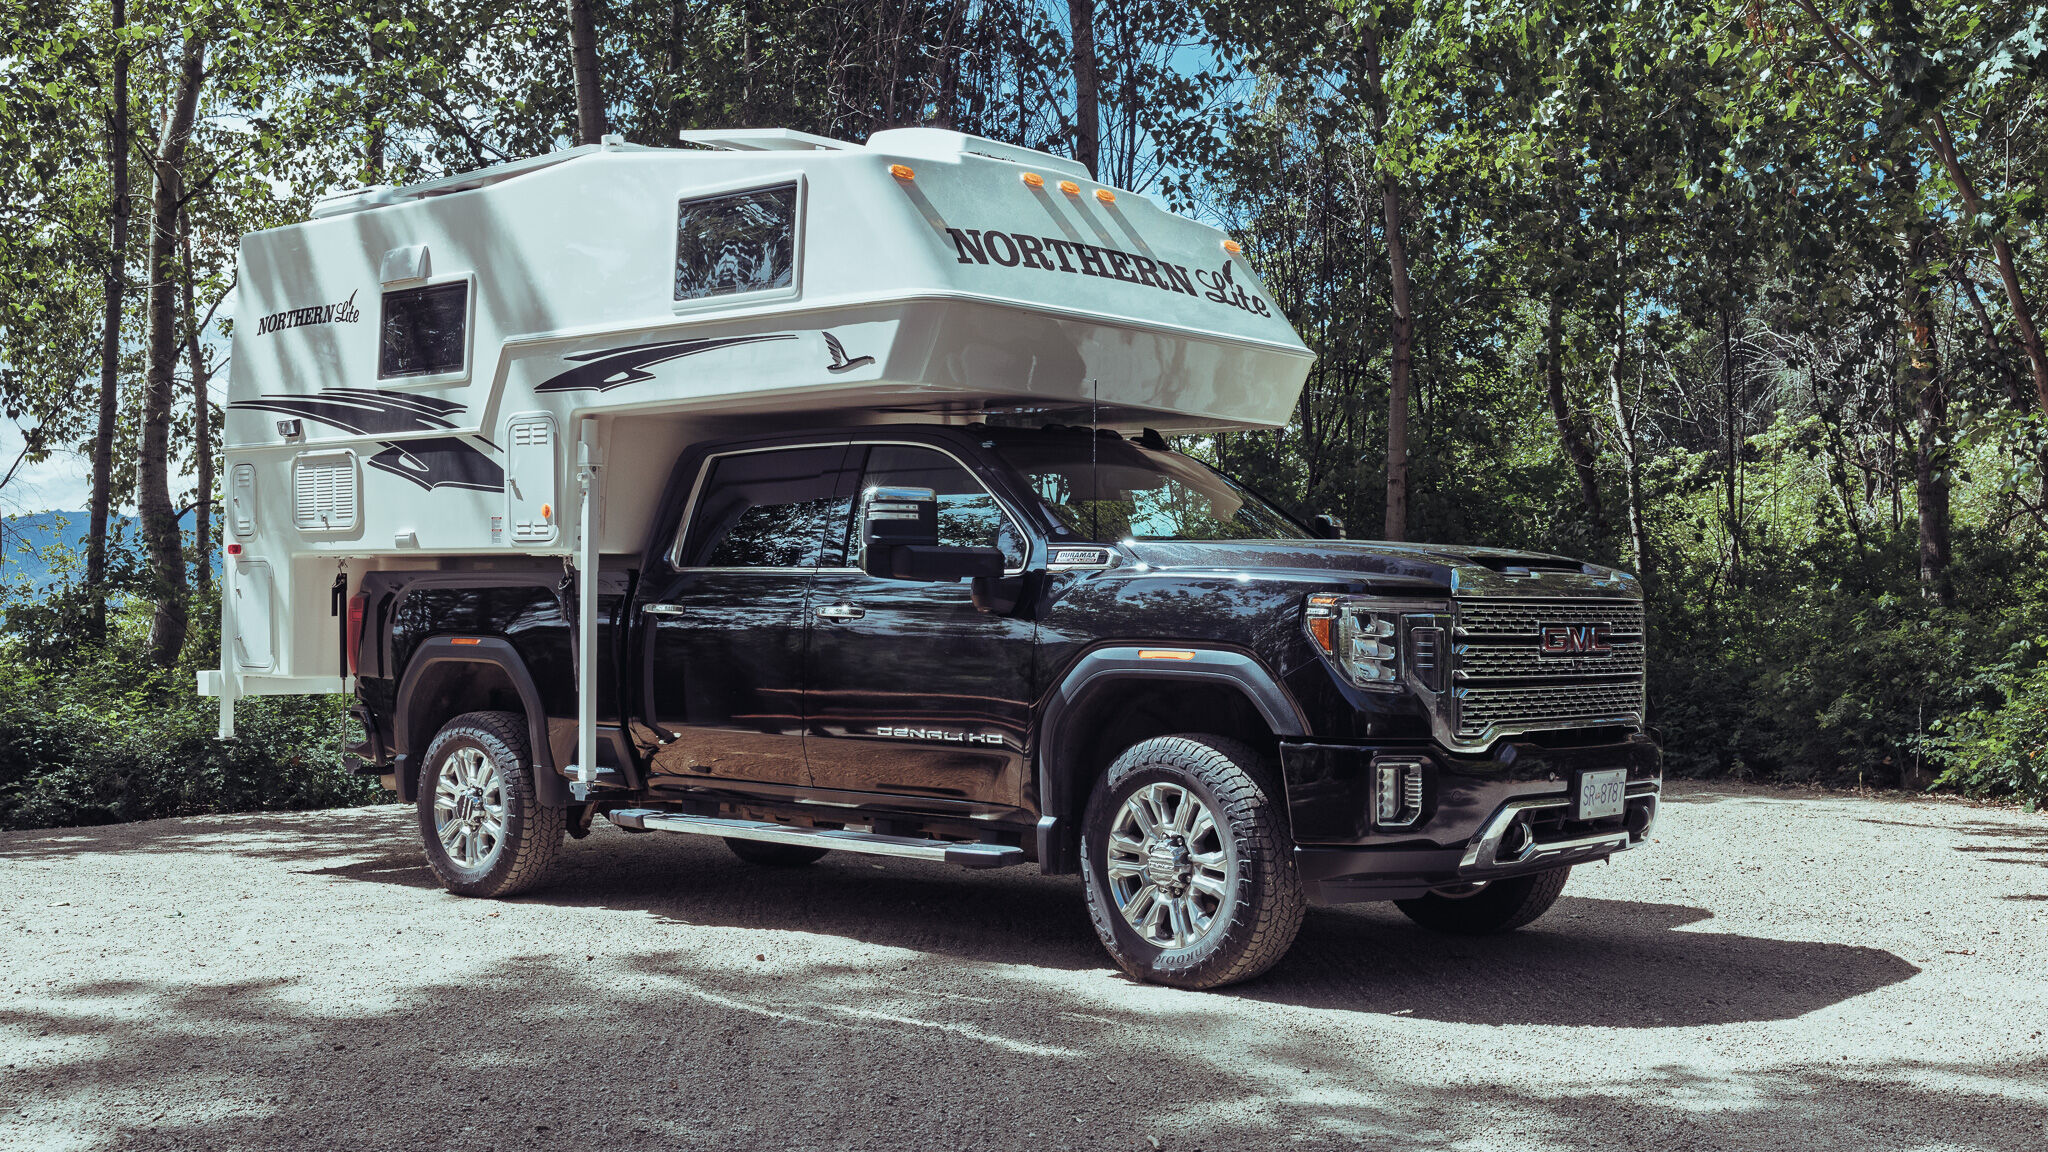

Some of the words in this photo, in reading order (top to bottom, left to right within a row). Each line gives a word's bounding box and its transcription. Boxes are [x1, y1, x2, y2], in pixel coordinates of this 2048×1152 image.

[946, 228, 1199, 297] NORTHERN
[1195, 260, 1271, 318] Lite
[257, 304, 336, 336] NORTHERN
[335, 289, 360, 323] Lite
[1541, 626, 1611, 652] GMC
[877, 727, 963, 742] DENALI
[968, 733, 1003, 744] HD
